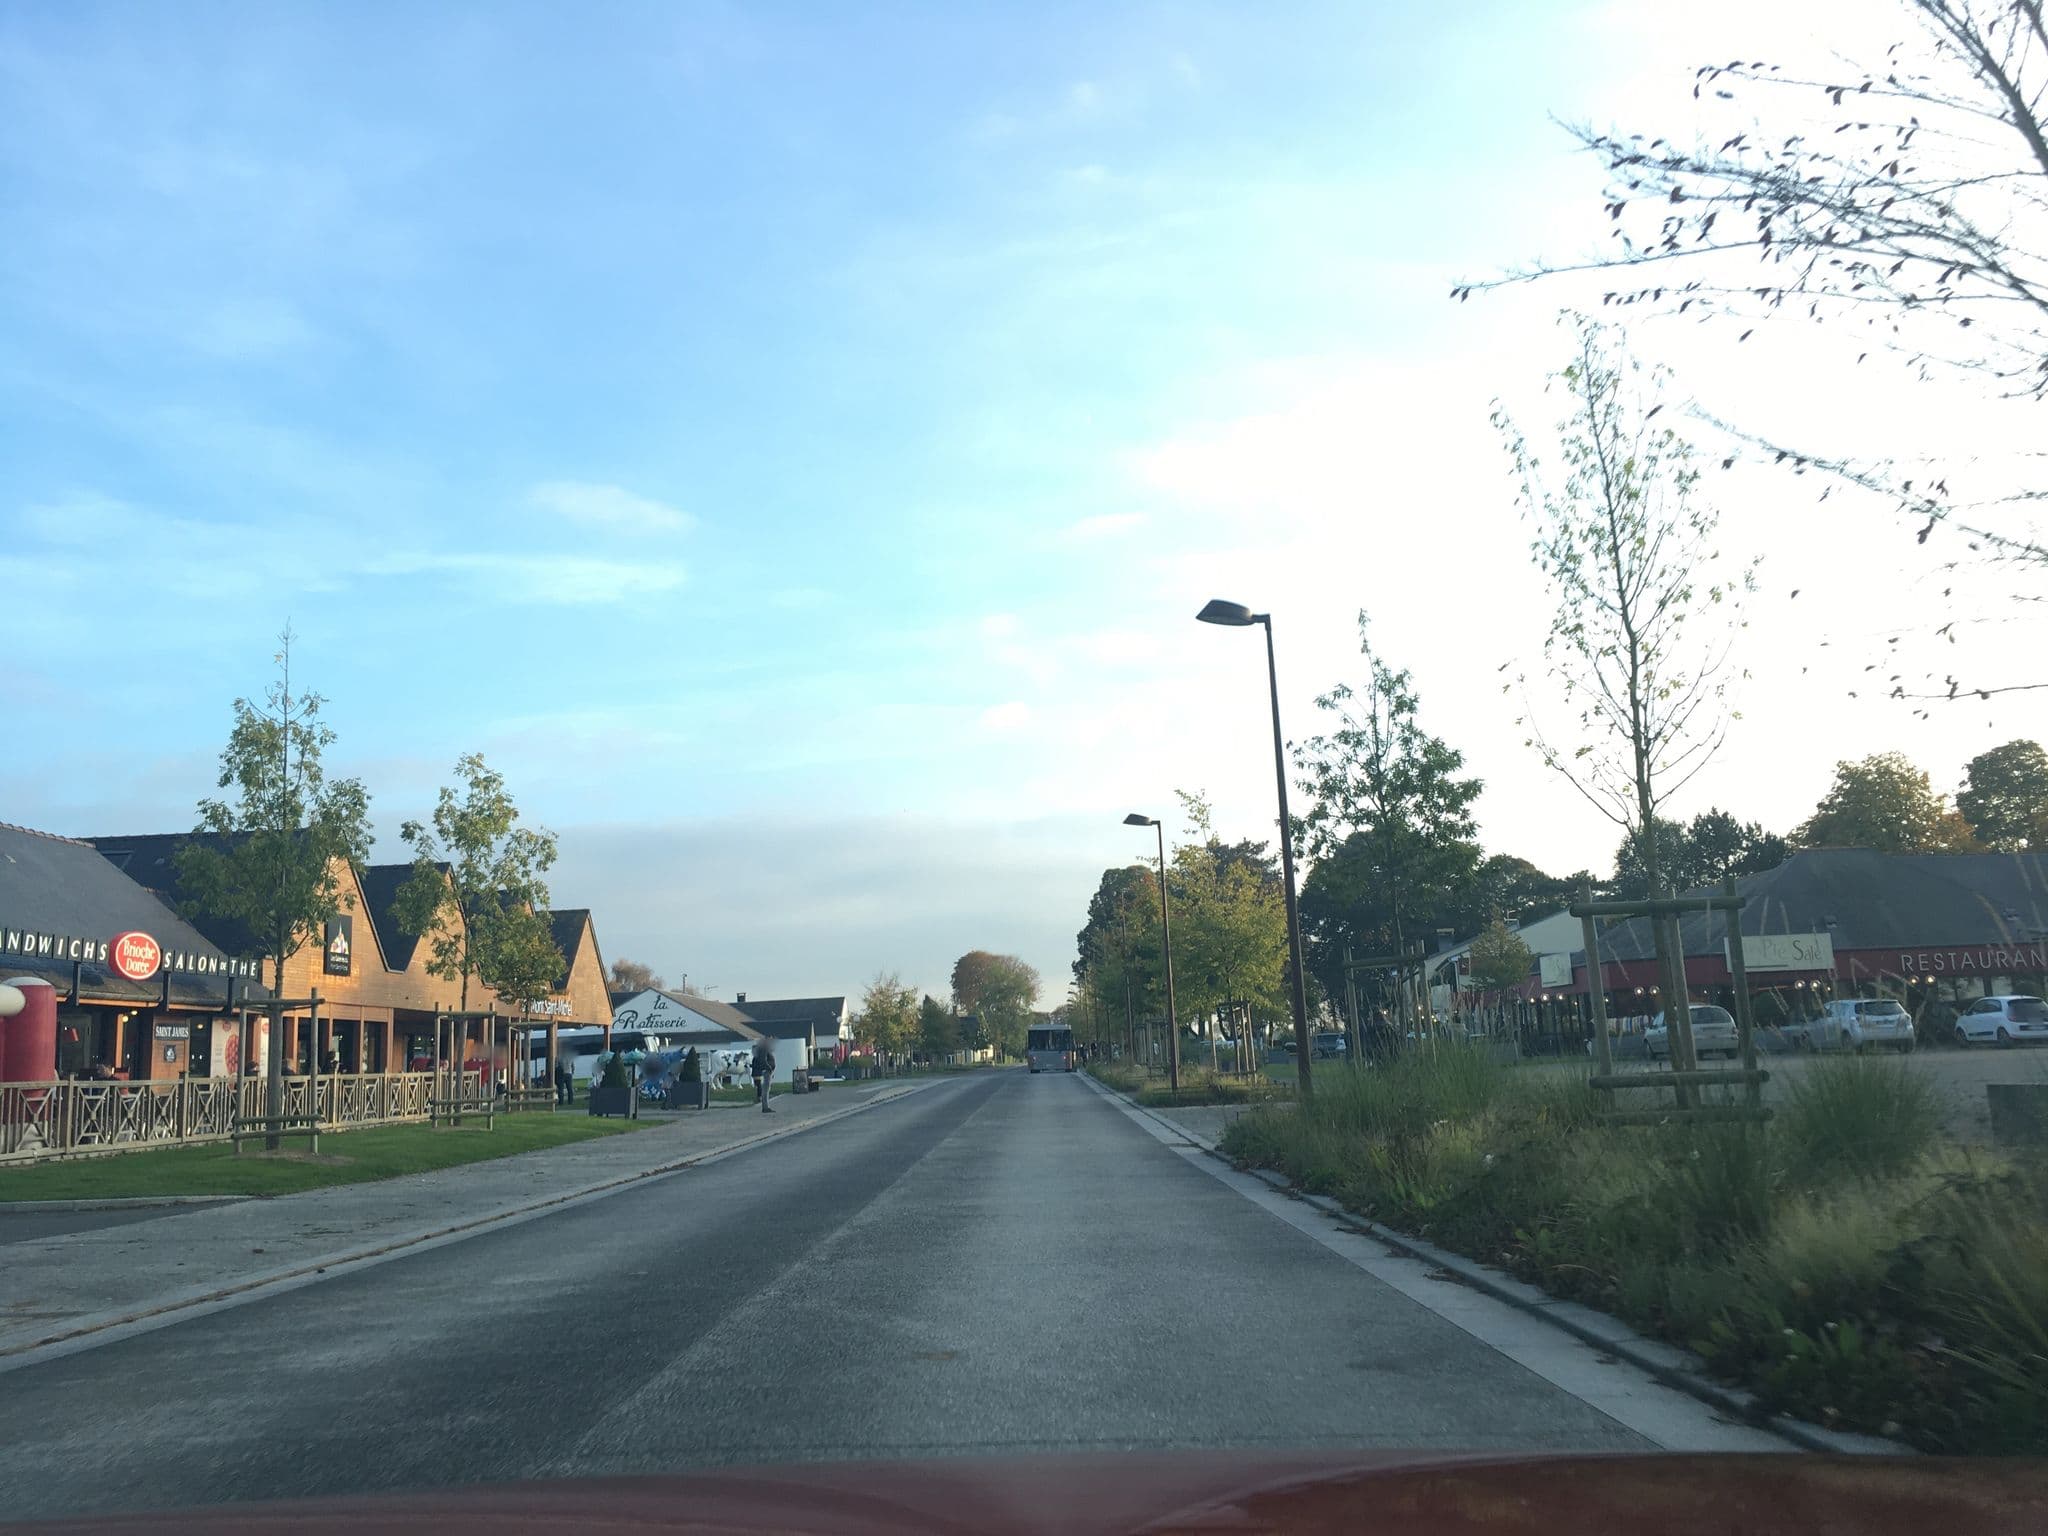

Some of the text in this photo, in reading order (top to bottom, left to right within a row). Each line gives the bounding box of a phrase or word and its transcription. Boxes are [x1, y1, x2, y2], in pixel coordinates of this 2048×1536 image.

[0, 931, 108, 961] NDWICHS
[123, 939, 156, 960] Brioche
[164, 951, 217, 973] SALON
[155, 1025, 189, 1038] SAINT JAMES
